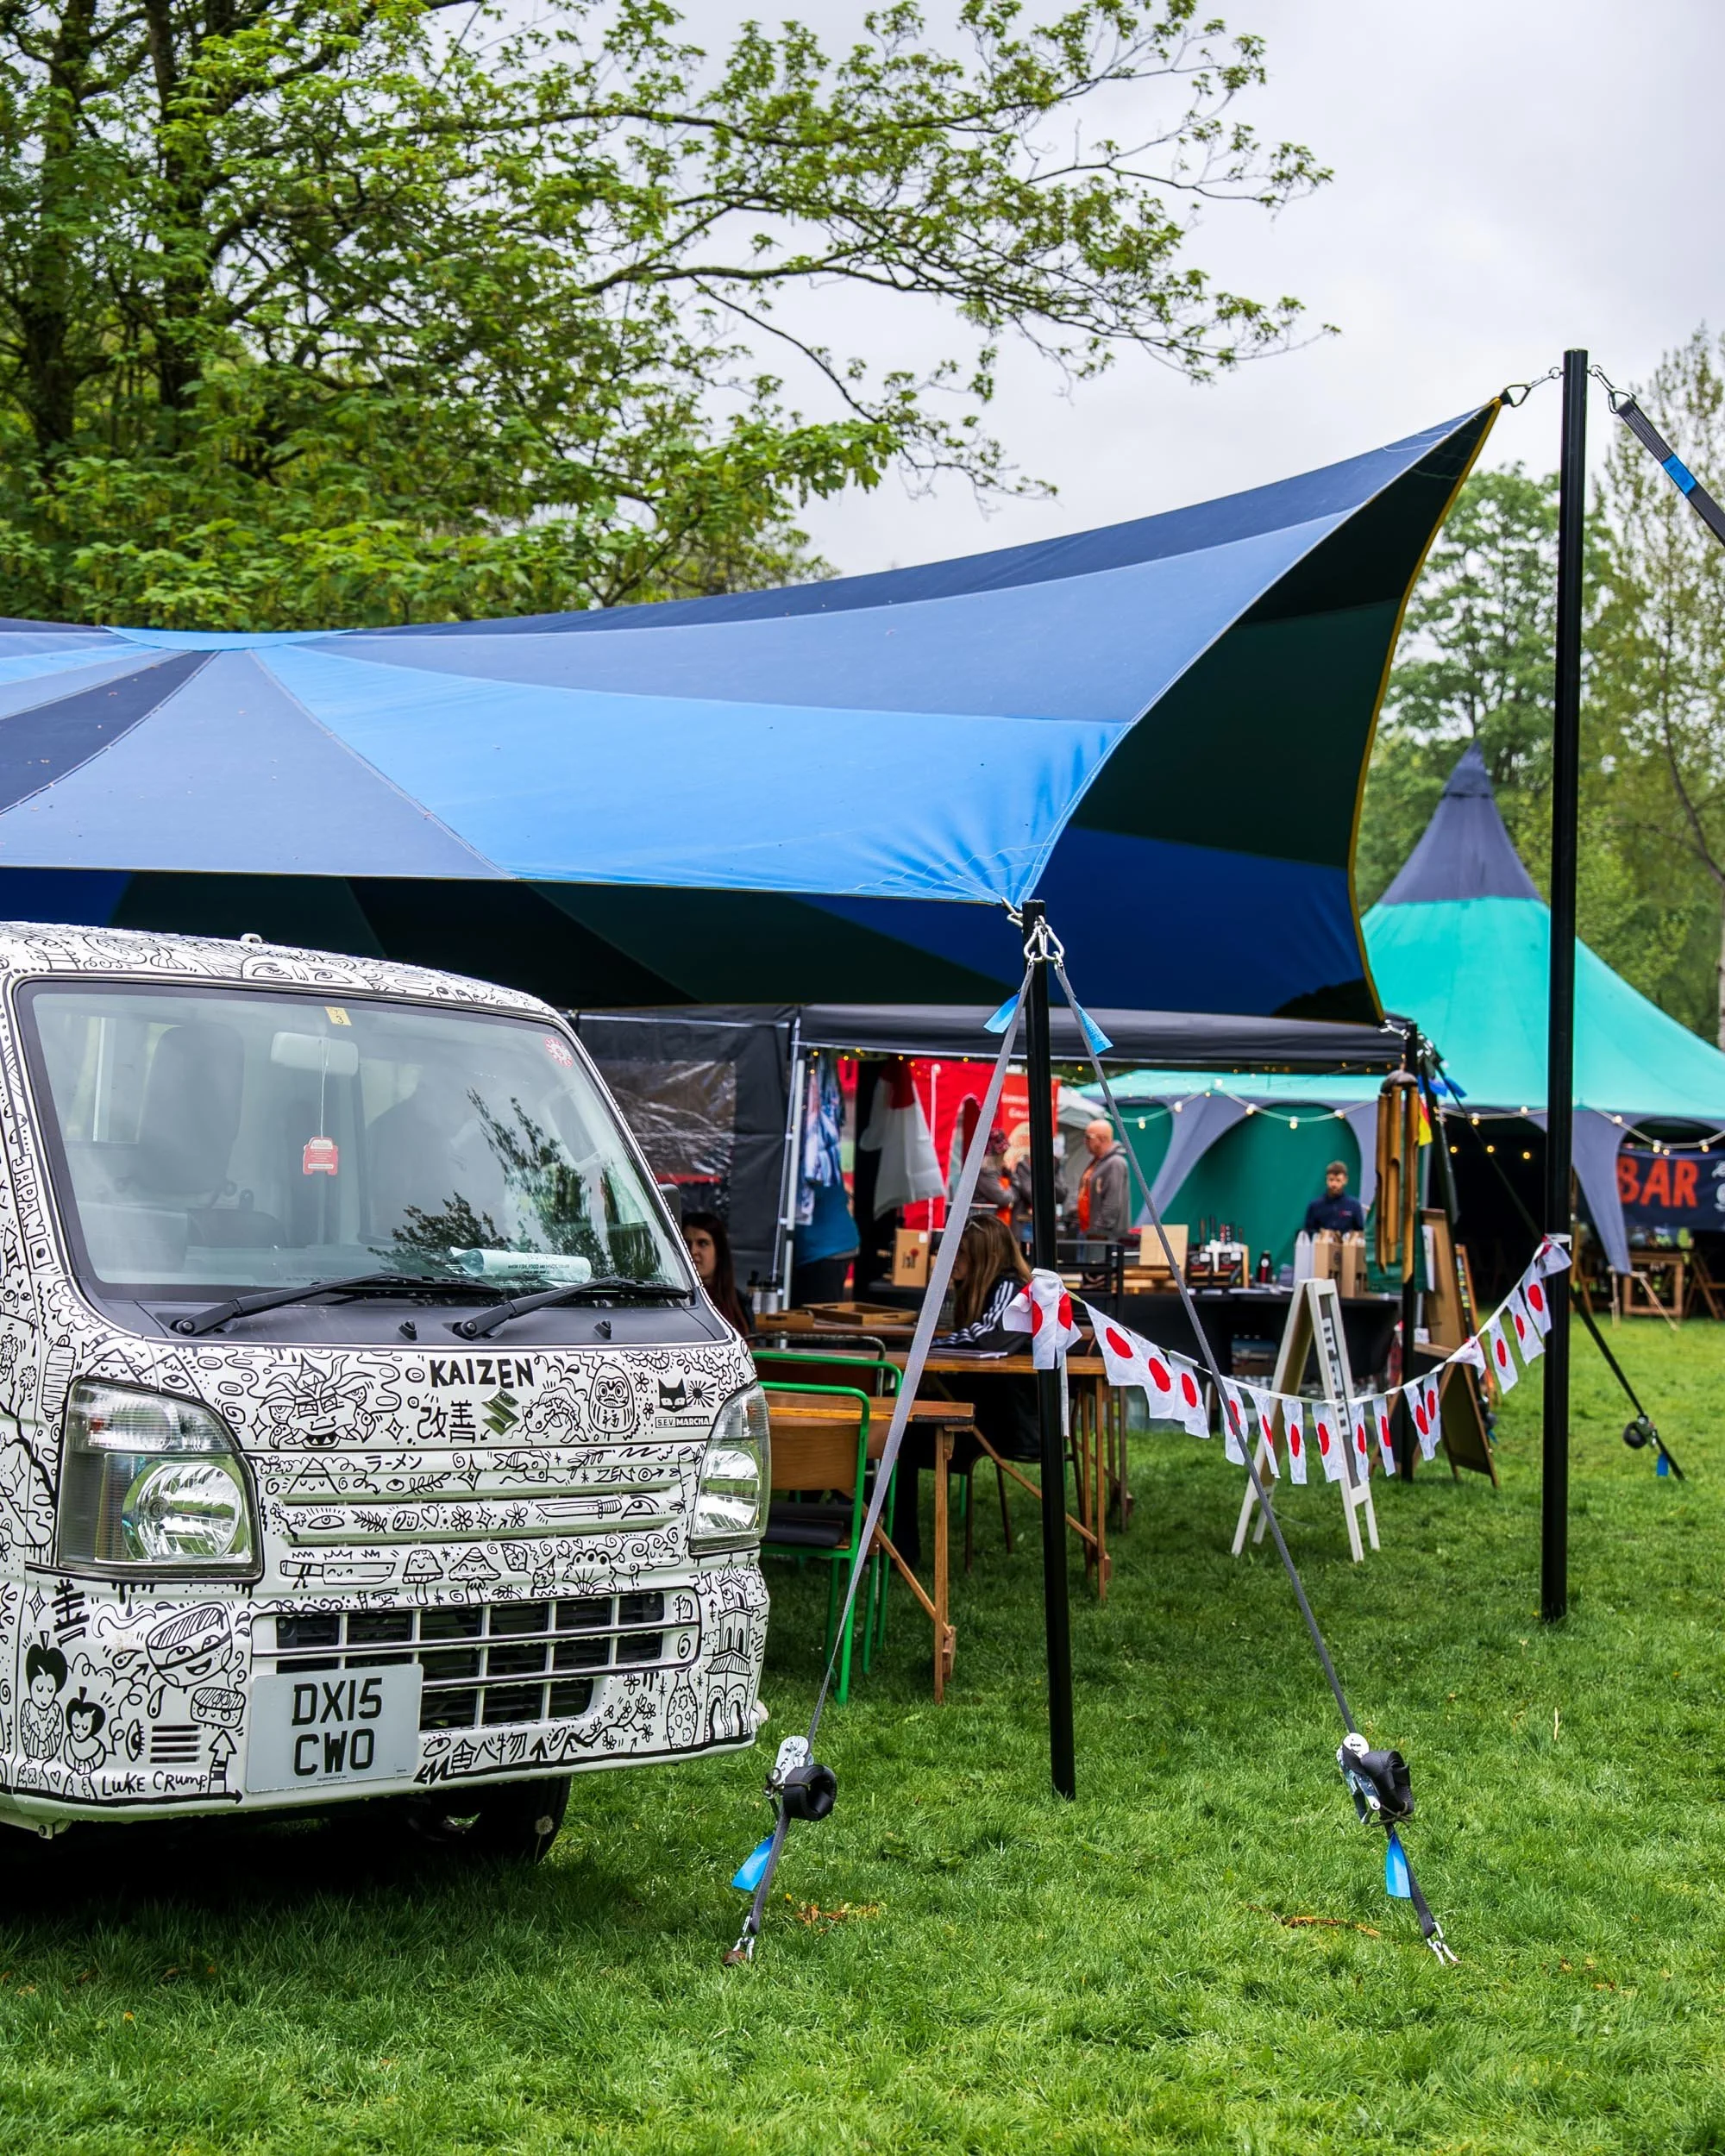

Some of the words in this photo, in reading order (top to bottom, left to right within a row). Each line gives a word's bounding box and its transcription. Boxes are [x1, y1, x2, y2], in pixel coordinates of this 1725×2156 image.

[11, 1153, 47, 1240] JAPAN
[1615, 1156, 1698, 1207] BAR
[430, 1357, 535, 1388] KAIZEN
[676, 1416, 710, 1426] MARCHA
[365, 1453, 423, 1474] ラーメン
[594, 1466, 636, 1482] ZEN
[292, 1677, 382, 1726] DX15
[294, 1728, 374, 1777] CWO
